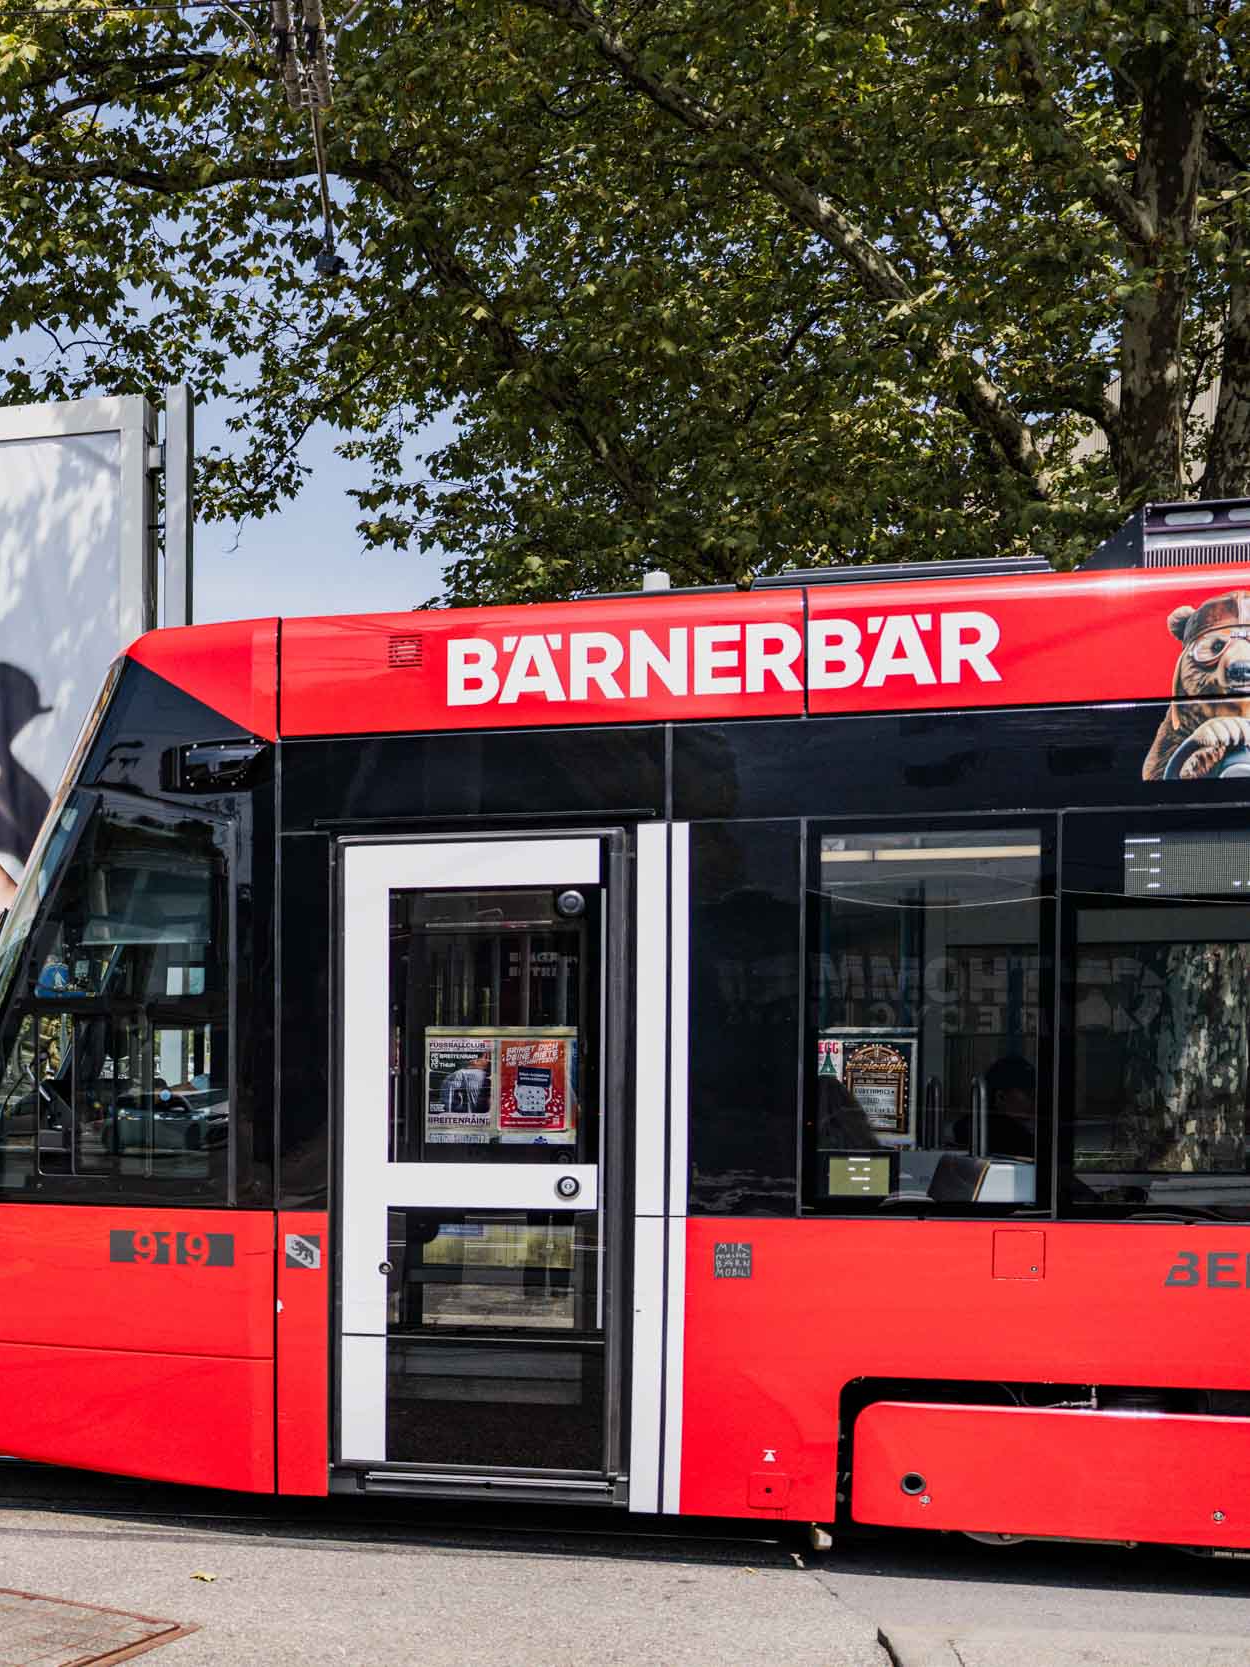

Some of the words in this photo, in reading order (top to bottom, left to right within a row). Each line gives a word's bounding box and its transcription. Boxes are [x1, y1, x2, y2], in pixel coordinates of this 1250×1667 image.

[446, 611, 1002, 707] BÄRNERBÄR
[131, 1230, 210, 1267] 919
[1164, 1251, 1250, 1288] BE
